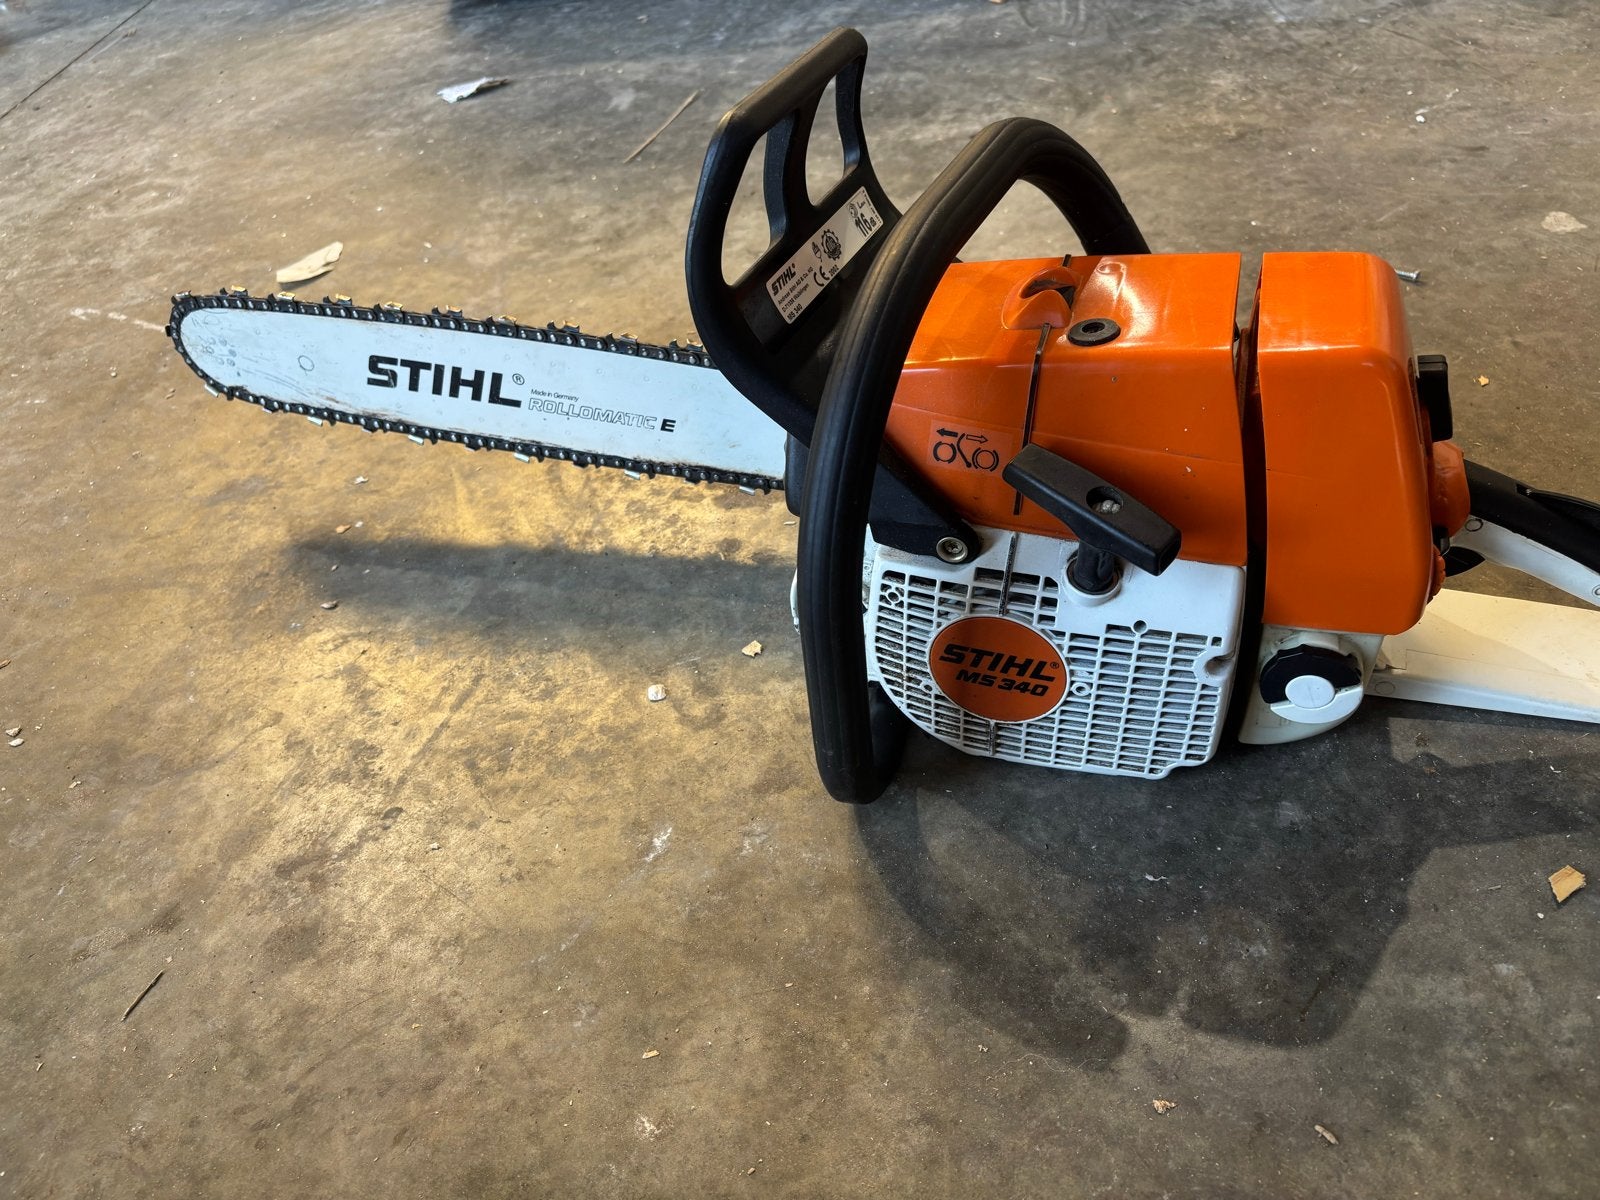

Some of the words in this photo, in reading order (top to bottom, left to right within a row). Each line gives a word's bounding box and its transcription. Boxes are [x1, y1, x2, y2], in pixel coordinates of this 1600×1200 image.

[531, 388, 547, 396] Made
[554, 392, 579, 402] Germany
[528, 398, 657, 430] ROLLOMATIC
[660, 418, 677, 433] E
[955, 669, 997, 687] MS
[997, 679, 1049, 697] 340
